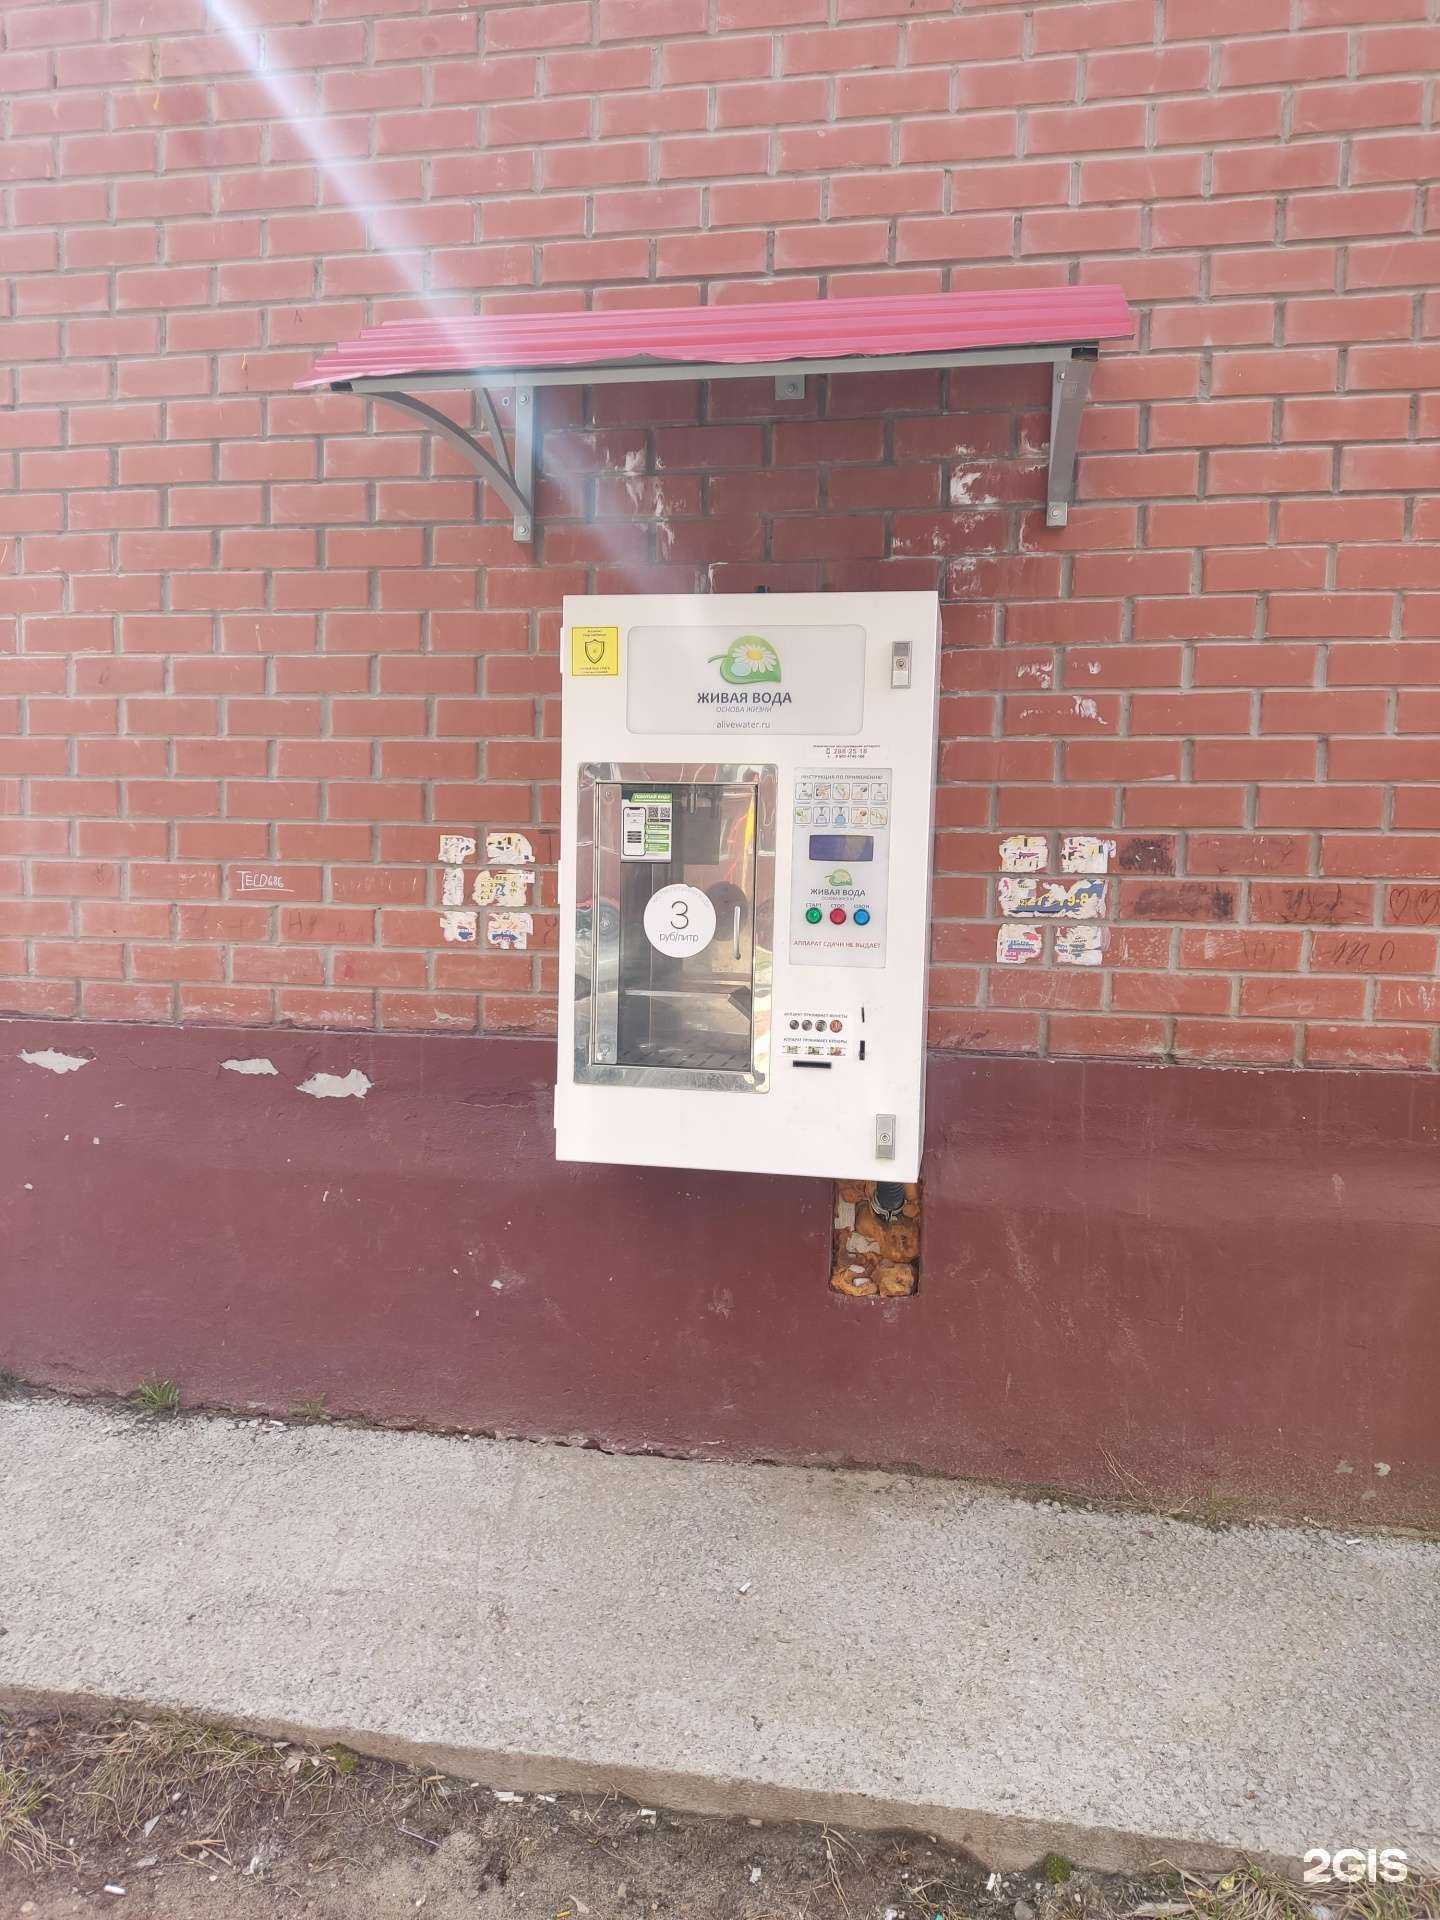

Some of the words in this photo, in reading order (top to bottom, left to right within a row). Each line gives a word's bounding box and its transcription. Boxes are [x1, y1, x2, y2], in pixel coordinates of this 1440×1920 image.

[697, 692, 748, 704] ЖИВАЯ
[752, 692, 792, 707] ВОДА
[716, 705, 745, 713] ОСНОВА
[716, 720, 771, 729] alivewater.ru
[810, 888, 840, 897] ЖИВАЯ
[842, 889, 866, 898] ВОДА
[670, 900, 689, 930] 3
[659, 931, 699, 943] руб/литр
